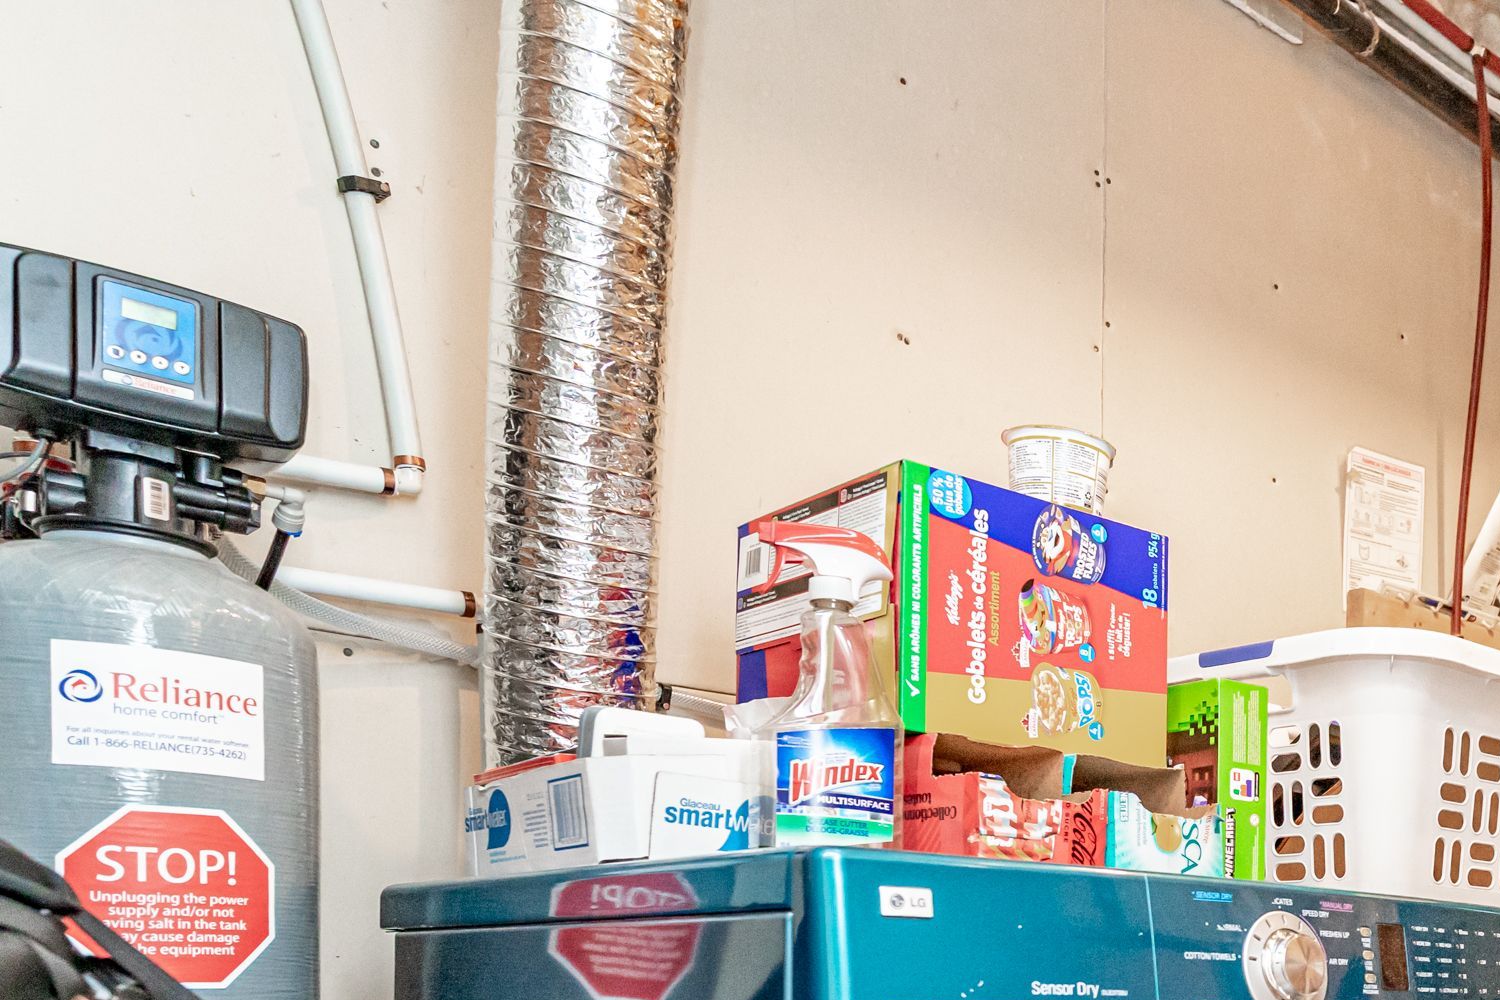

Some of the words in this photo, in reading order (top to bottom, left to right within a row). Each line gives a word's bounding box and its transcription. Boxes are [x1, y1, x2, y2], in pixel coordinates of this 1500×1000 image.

[931, 488, 943, 505] 50
[943, 490, 955, 514] plus
[911, 484, 923, 542] ARTIFICIELS
[1150, 533, 1160, 541] g
[966, 509, 989, 594] céréales
[1072, 532, 1090, 580] FROSTED
[1148, 540, 1158, 558] 954
[911, 543, 922, 600] COLORANTS
[1084, 541, 1098, 580] FLAKES
[911, 601, 921, 611] NI
[944, 573, 964, 626] Kellogg's
[972, 596, 984, 610] de
[988, 570, 1000, 646] Assortiment
[1142, 587, 1158, 609] 18
[909, 612, 921, 653] ARÔMES
[1062, 602, 1077, 647] FROOT
[1106, 629, 1116, 655] suffit
[910, 654, 921, 682] SANS
[965, 611, 987, 704] Gobelets
[109, 671, 257, 717] Reliance
[1074, 672, 1095, 726] POPS!
[113, 703, 157, 718] home
[161, 707, 218, 725] comfort
[67, 735, 90, 747] Call
[680, 798, 720, 811] Glaceau
[817, 795, 890, 811] MULTISURFACE
[903, 805, 957, 822] Collectionn
[1119, 792, 1129, 823] NETTES
[1180, 818, 1203, 875] SCA
[1224, 807, 1236, 879] MINECRAFT
[95, 844, 237, 887] STOP!
[89, 890, 181, 906] Unplugging
[183, 892, 207, 905] the
[209, 895, 249, 909] power
[910, 898, 926, 908] LG
[1195, 891, 1220, 900] SENSOR
[1221, 892, 1233, 900] DRY
[108, 905, 159, 918] supply
[162, 905, 209, 917] and/or
[213, 907, 234, 918] not
[103, 918, 145, 932] aving
[148, 918, 175, 930] salt
[177, 918, 191, 930] in
[194, 919, 217, 930] the
[219, 920, 247, 931] tank
[1320, 930, 1340, 938] FRESHEN
[1341, 931, 1350, 939] UP
[120, 932, 138, 944] ay
[142, 933, 184, 943] cause
[187, 932, 240, 946] damage
[138, 943, 157, 955] he
[159, 944, 235, 958] equipment
[1184, 951, 1236, 961] COTTON/TOWELS
[1031, 980, 1074, 996] Sensor
[1077, 981, 1100, 999] Dry
